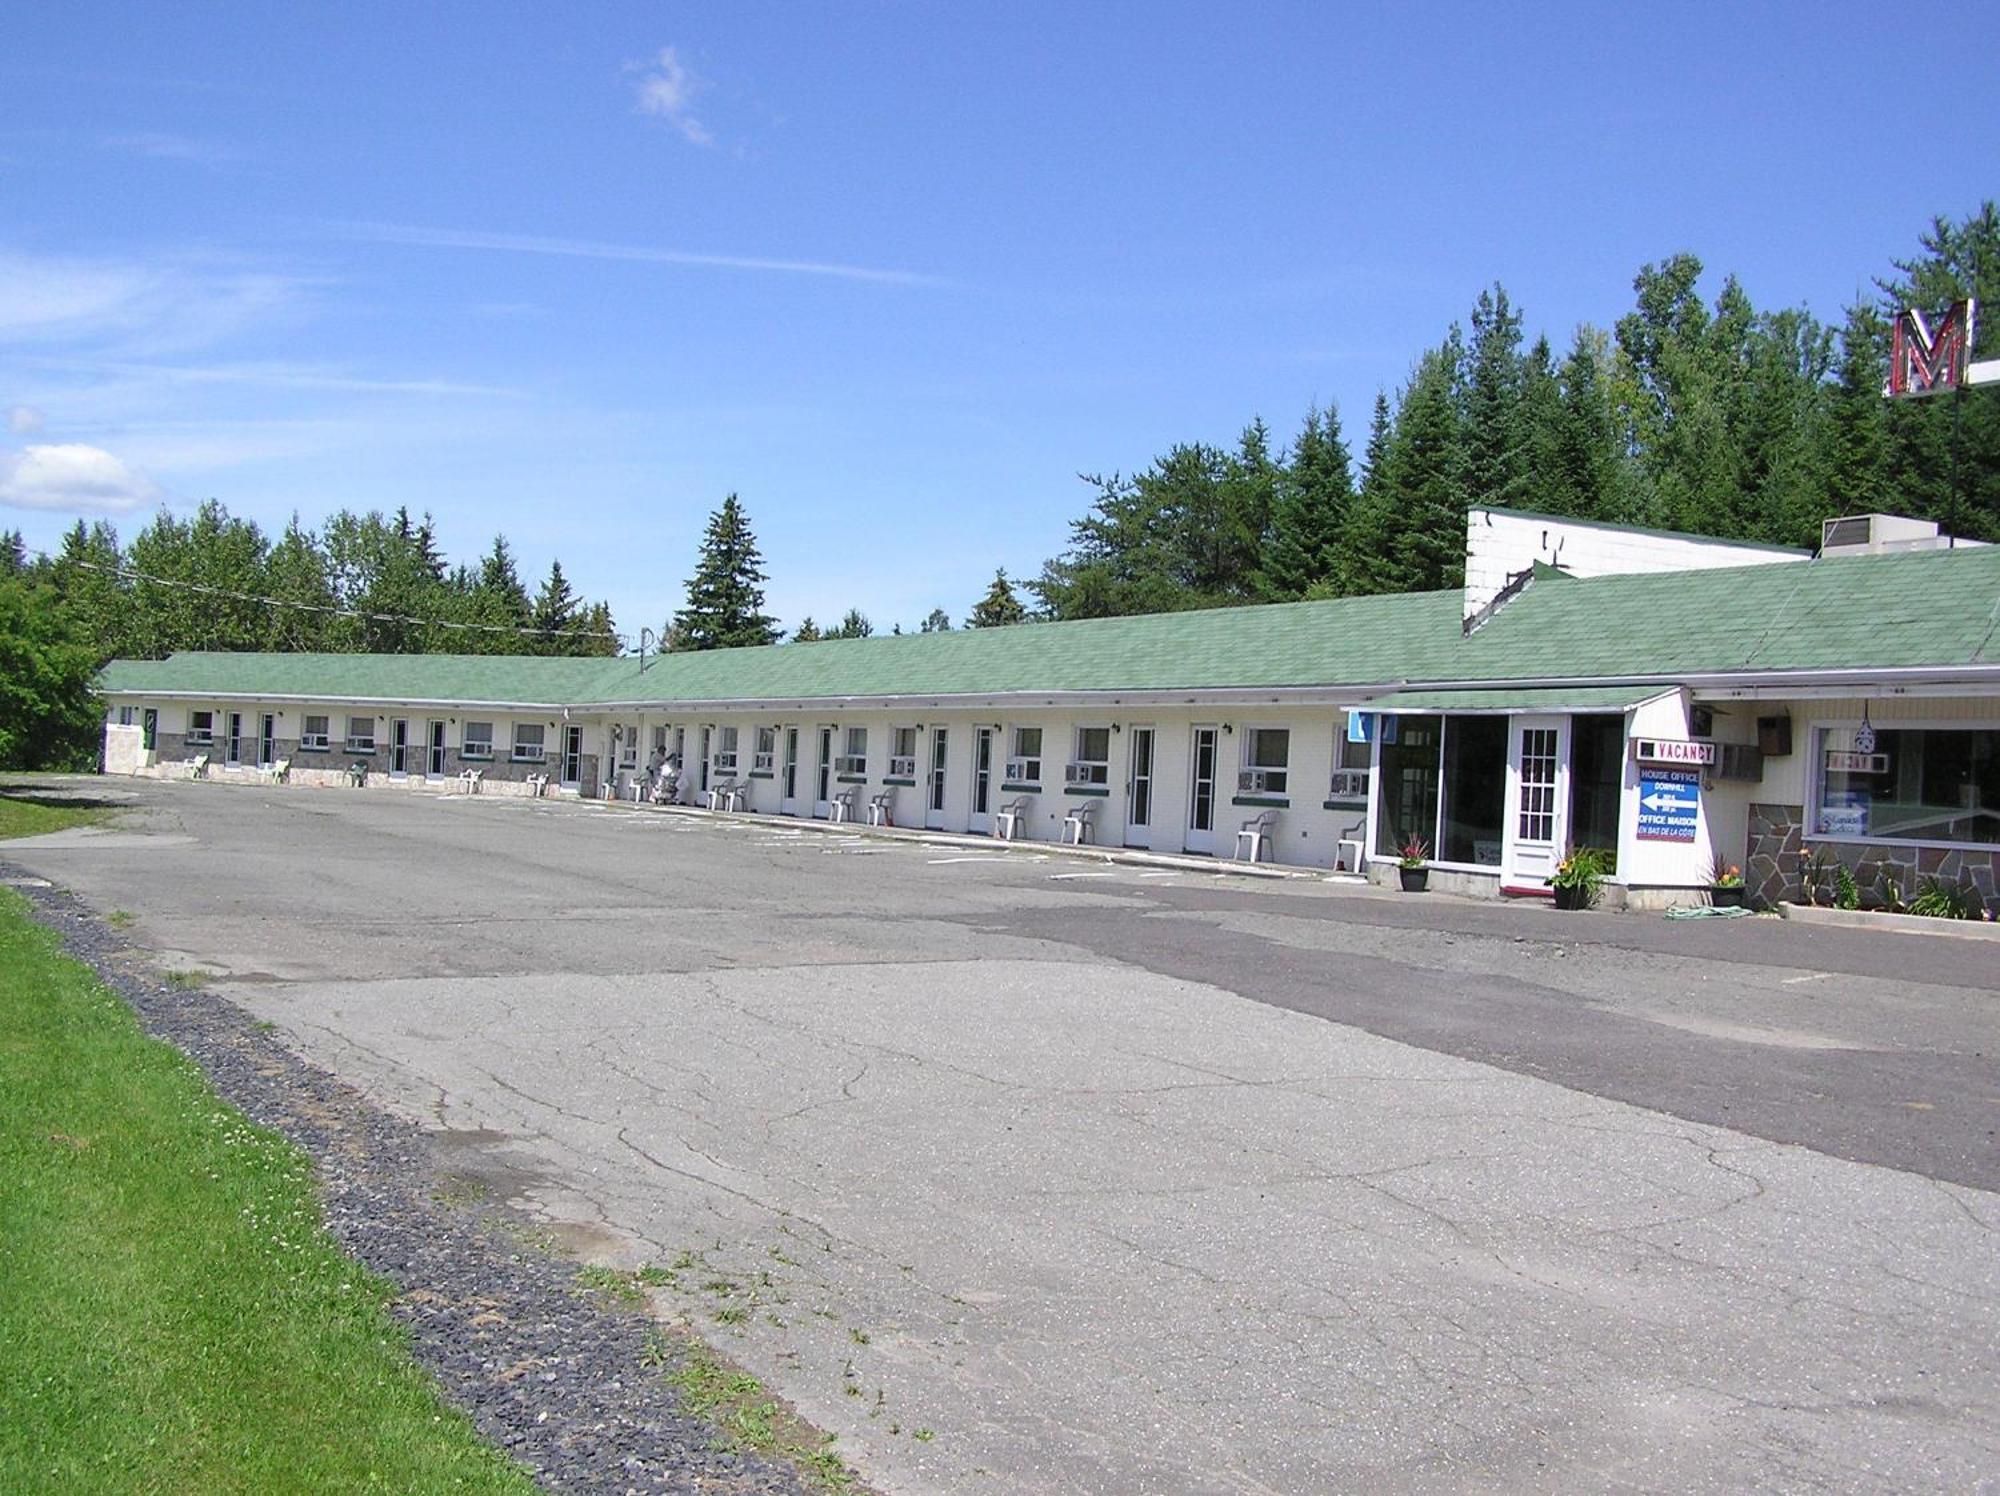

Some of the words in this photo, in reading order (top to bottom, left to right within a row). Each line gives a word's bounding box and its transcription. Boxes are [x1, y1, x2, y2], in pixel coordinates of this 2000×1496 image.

[1890, 299, 1975, 395] M
[1660, 743, 1712, 760] VACANCY
[1641, 770, 1668, 780] HOUSE
[1671, 772, 1697, 782] OFFICE
[1640, 815, 1666, 825] OFFICE
[1668, 816, 1696, 826] MAISON
